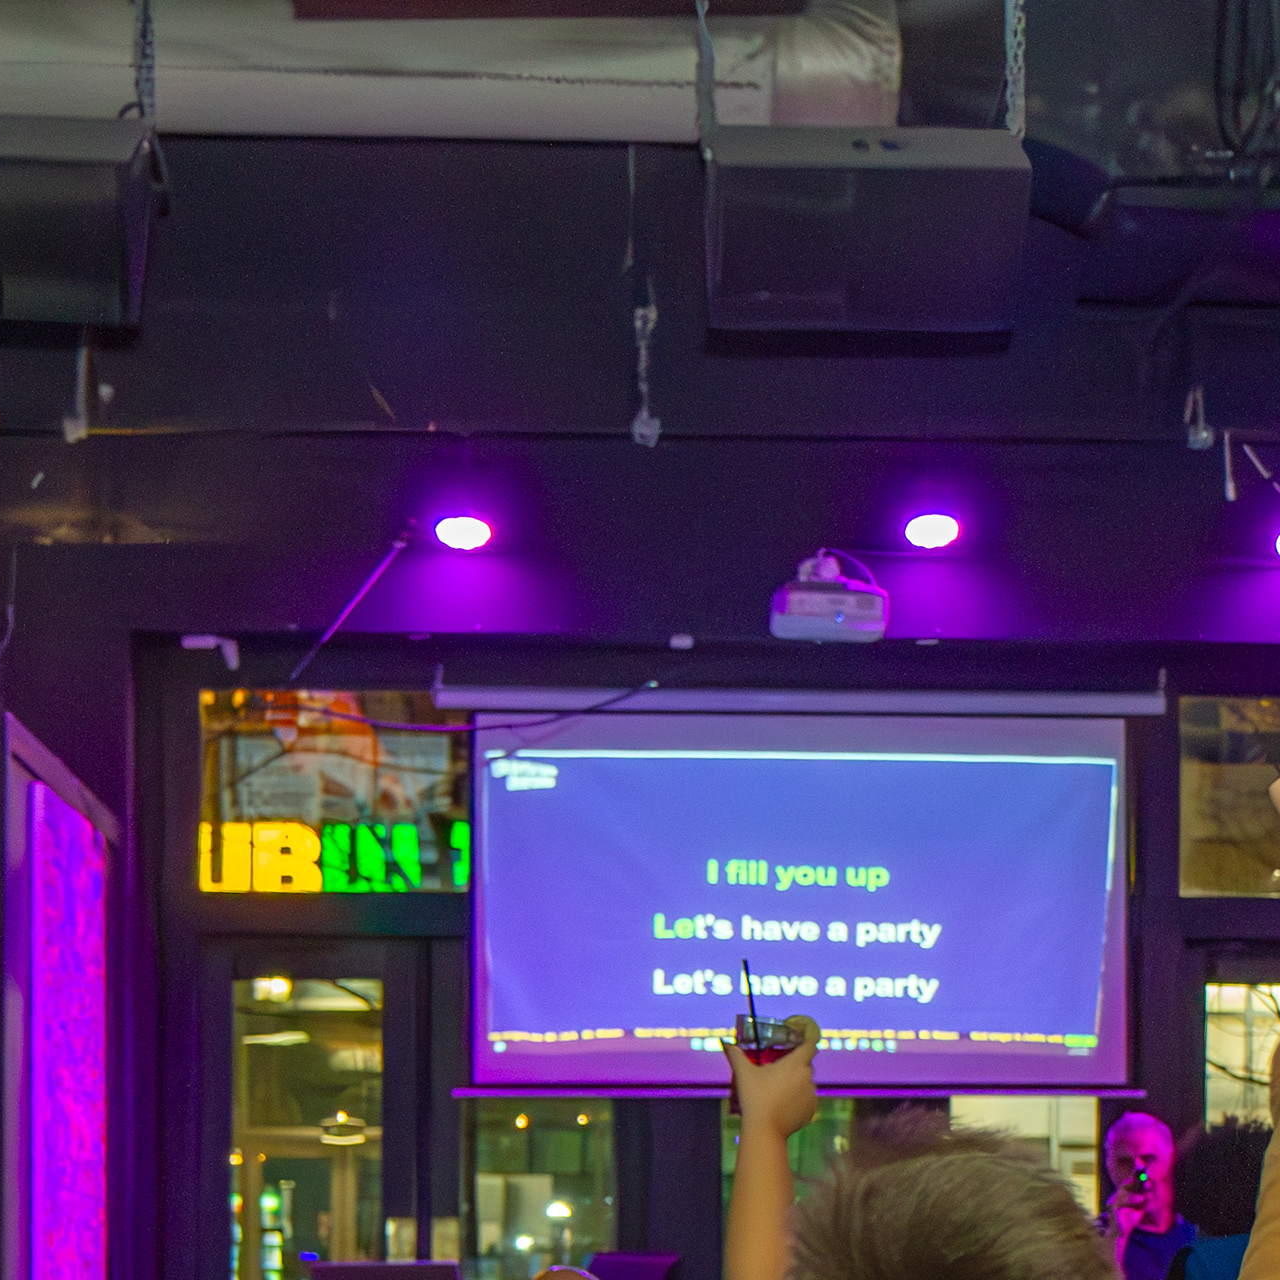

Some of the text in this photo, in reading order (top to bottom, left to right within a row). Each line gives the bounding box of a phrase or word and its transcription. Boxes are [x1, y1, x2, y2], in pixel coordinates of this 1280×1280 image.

[707, 859, 890, 892] I fill you up
[653, 913, 942, 949] Let's have a party
[653, 968, 939, 1004] Let's have a party
